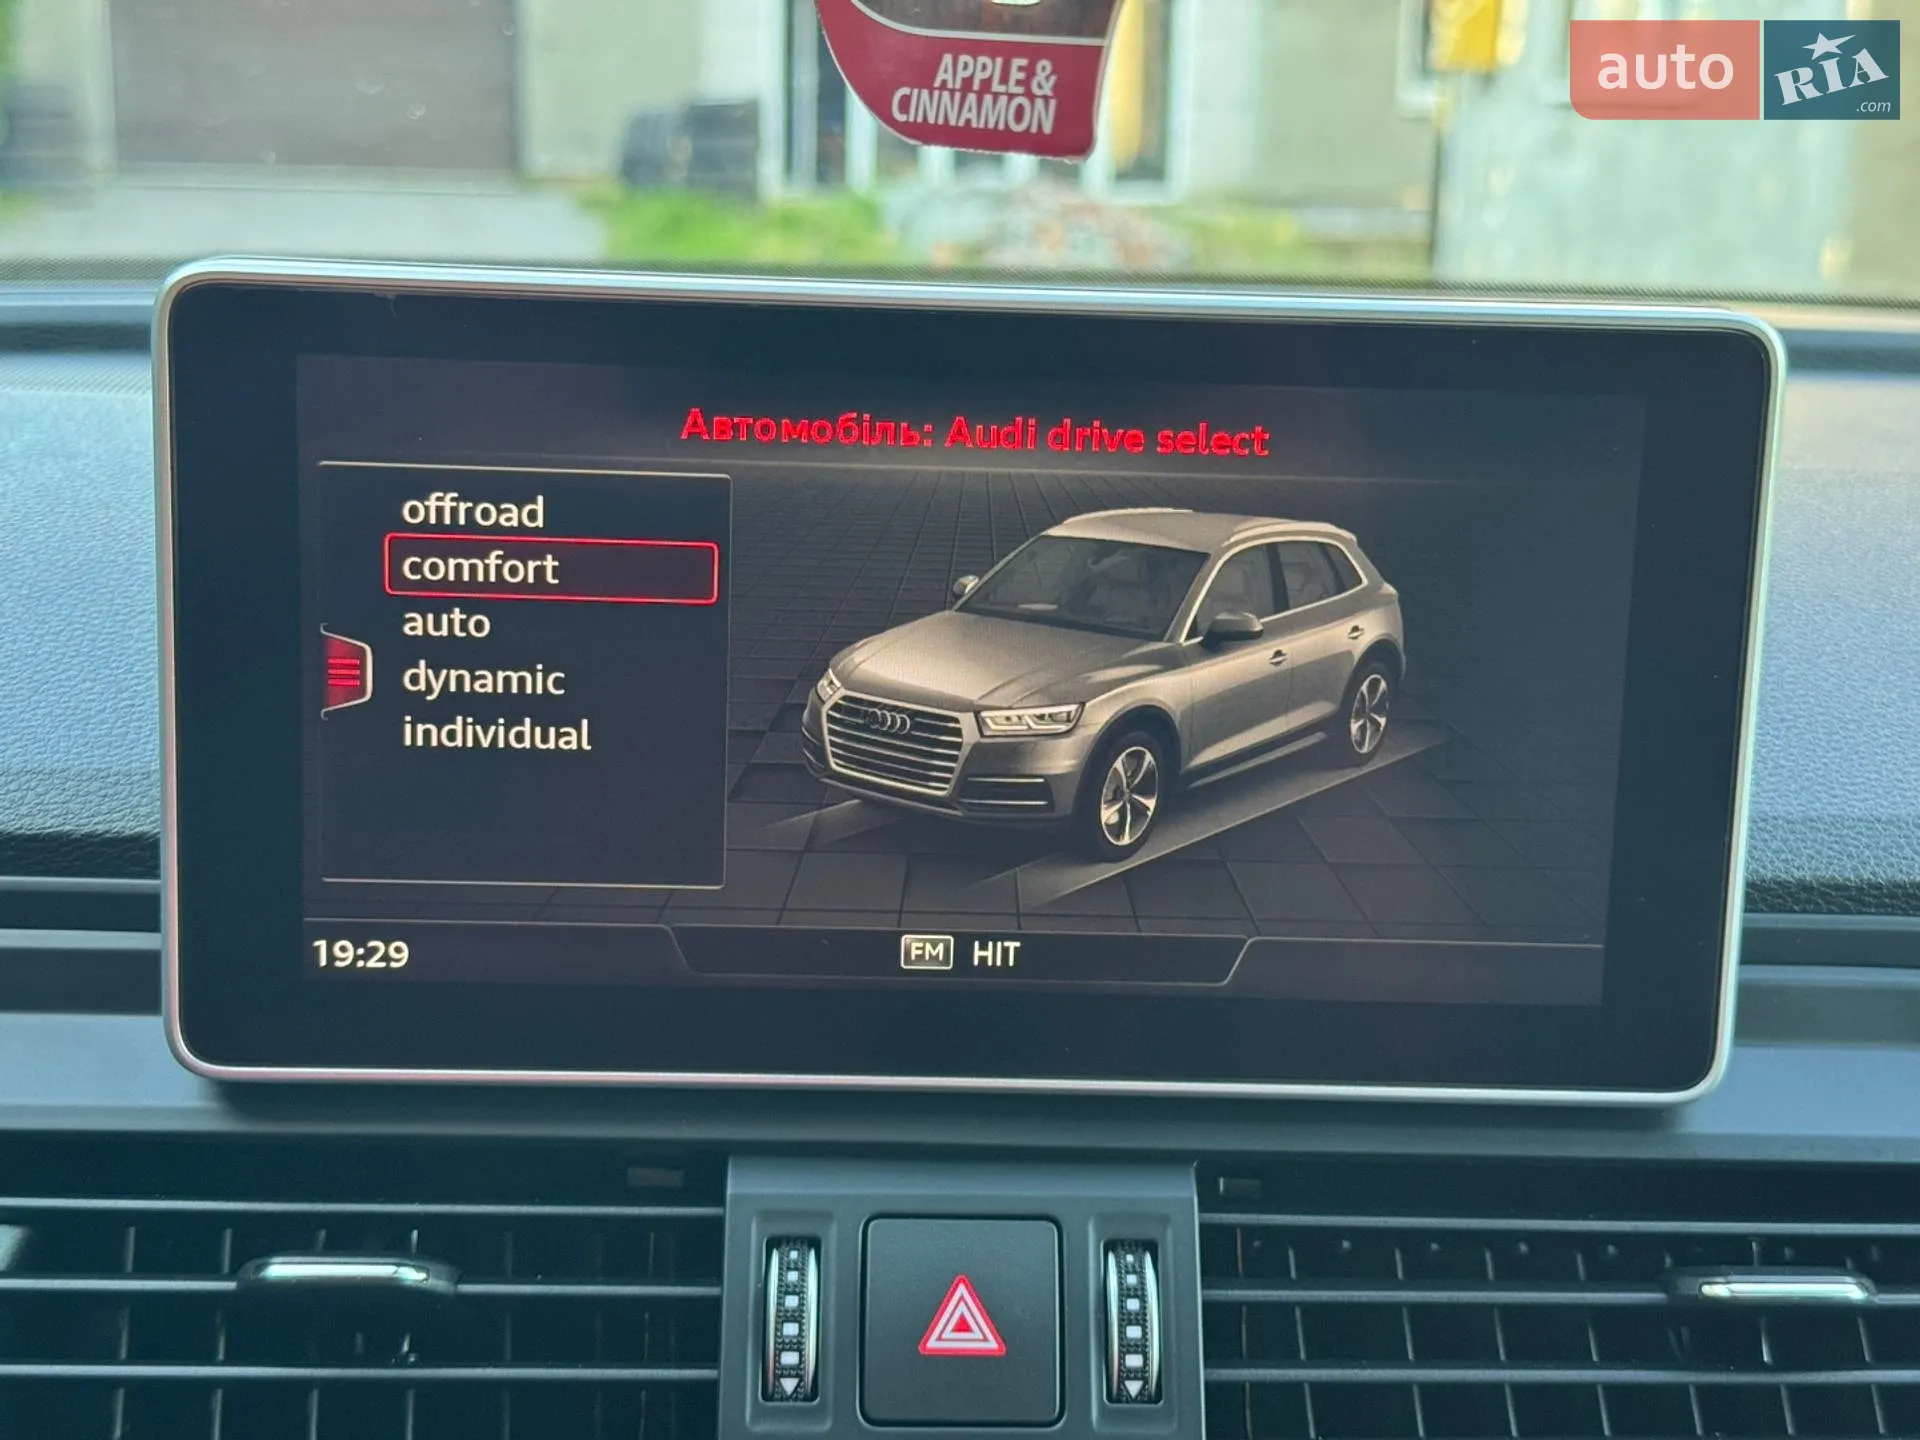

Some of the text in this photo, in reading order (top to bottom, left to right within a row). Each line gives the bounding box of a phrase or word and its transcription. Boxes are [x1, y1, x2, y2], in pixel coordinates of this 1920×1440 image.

[934, 53, 1057, 96] APPLE &
[892, 87, 1057, 134] CINNAMON
[680, 407, 1270, 456] Автомобіль: Audi drive select
[402, 492, 544, 528] offroad
[402, 550, 560, 584] comfort
[402, 607, 491, 638] auto
[402, 659, 566, 700] dynamic
[403, 715, 592, 751] individual
[312, 939, 409, 968] 19:29
[910, 940, 1021, 967] FM HIT
